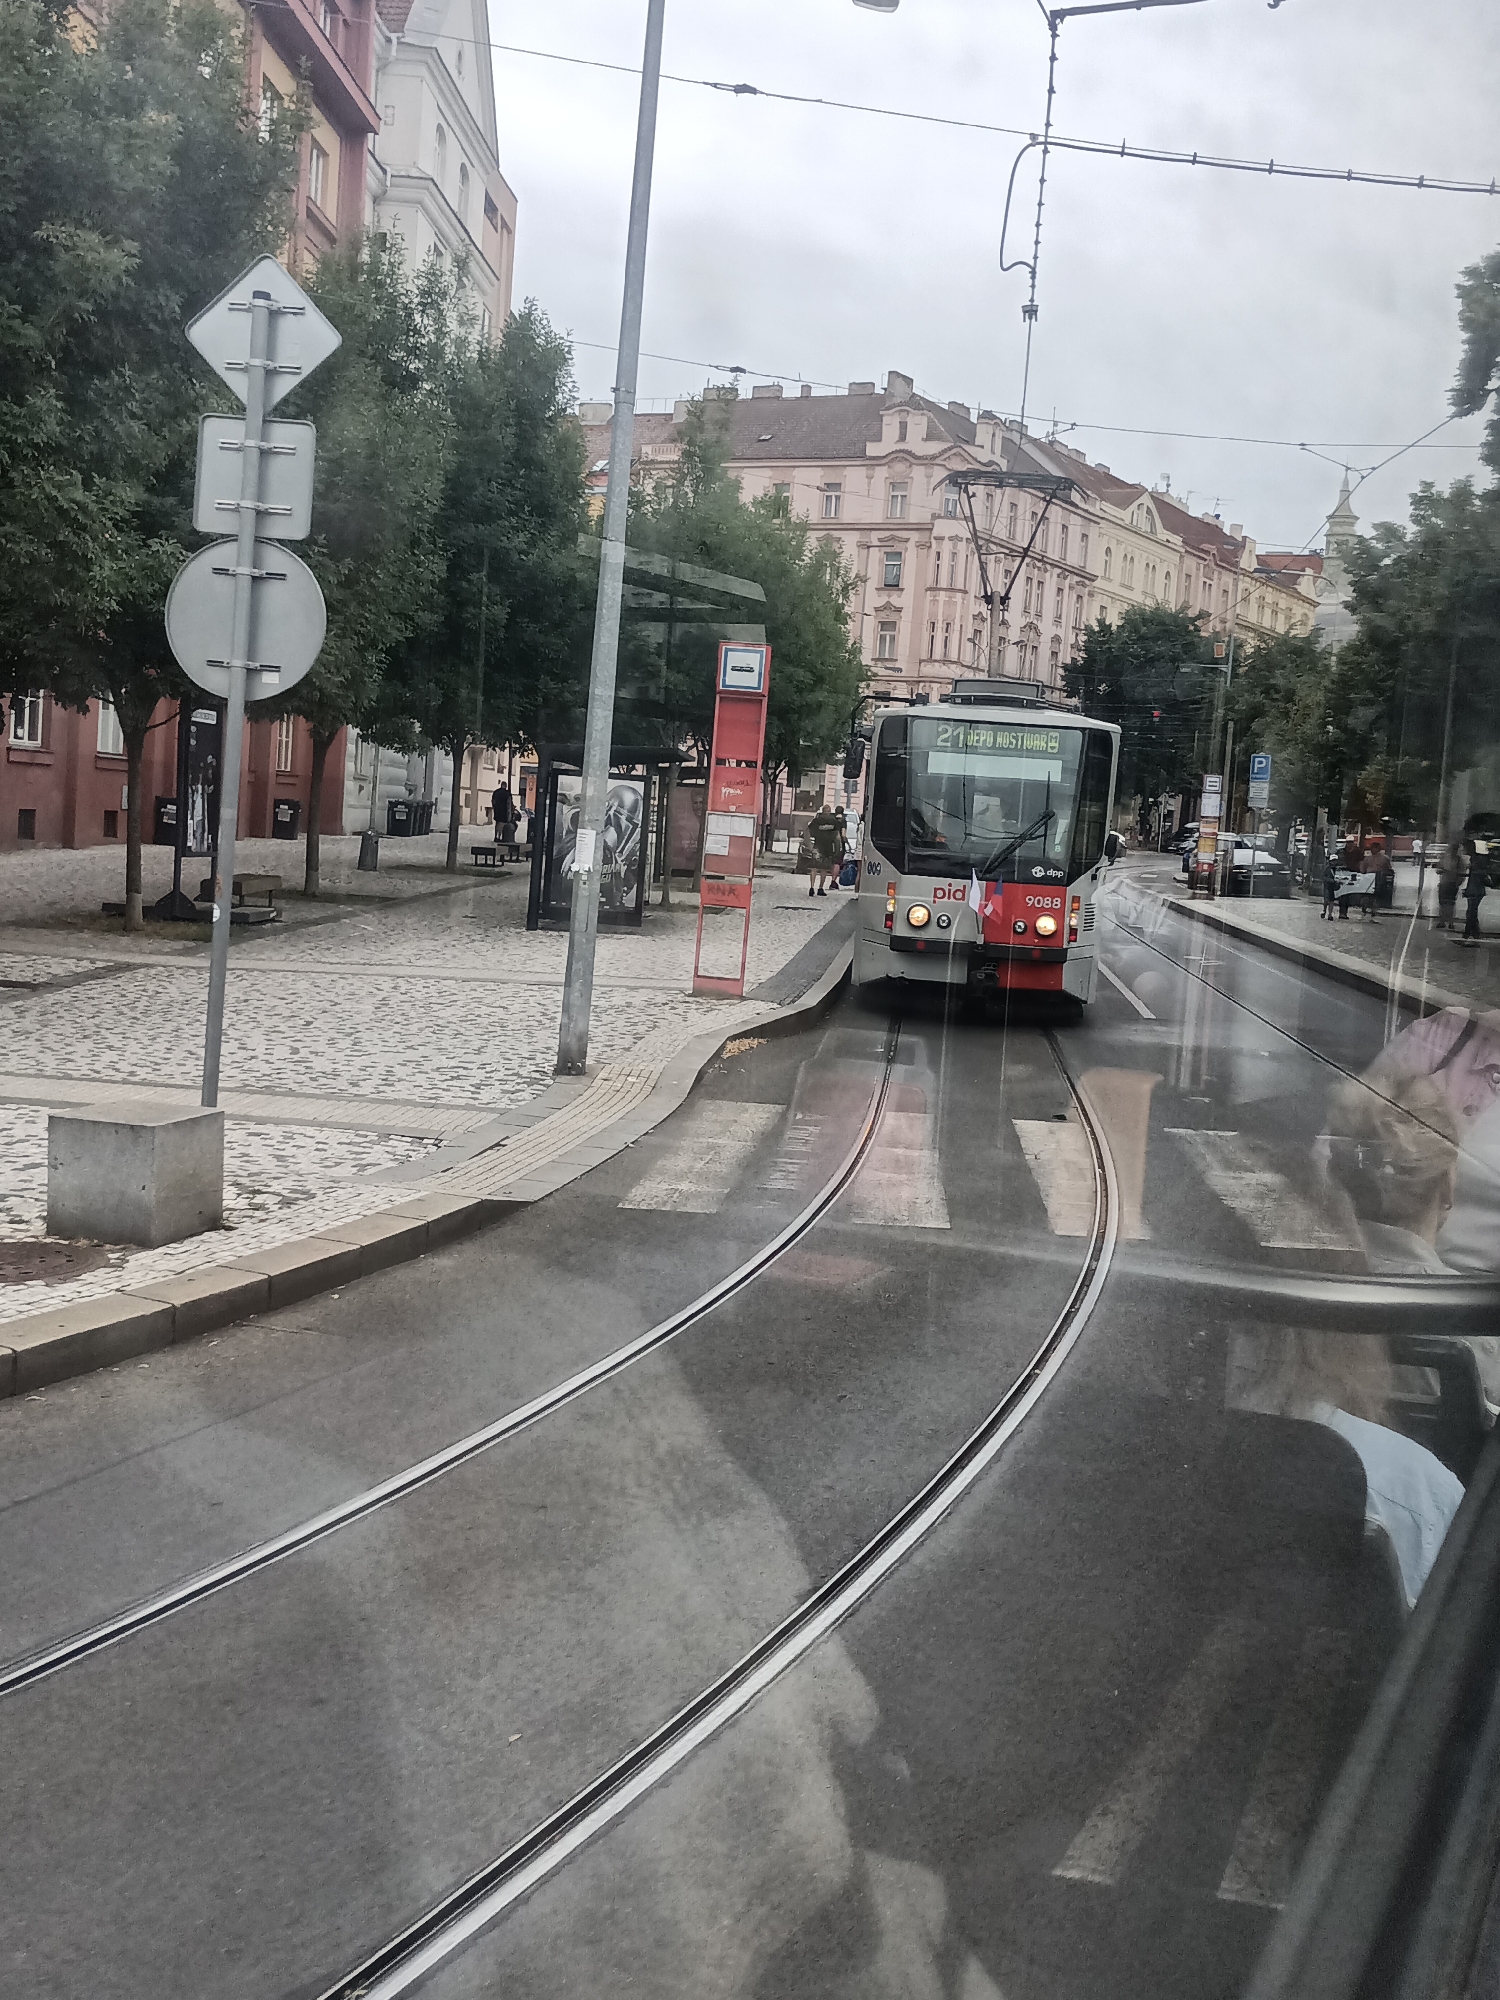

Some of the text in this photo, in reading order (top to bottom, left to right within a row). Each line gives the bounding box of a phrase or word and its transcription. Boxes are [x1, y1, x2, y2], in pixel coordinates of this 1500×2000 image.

[936, 724, 966, 748] 21
[967, 729, 994, 748] DEPO
[1253, 758, 1267, 773] P
[1046, 868, 1064, 879] dpp
[933, 883, 967, 904] pid
[1025, 895, 1062, 909] 9088
